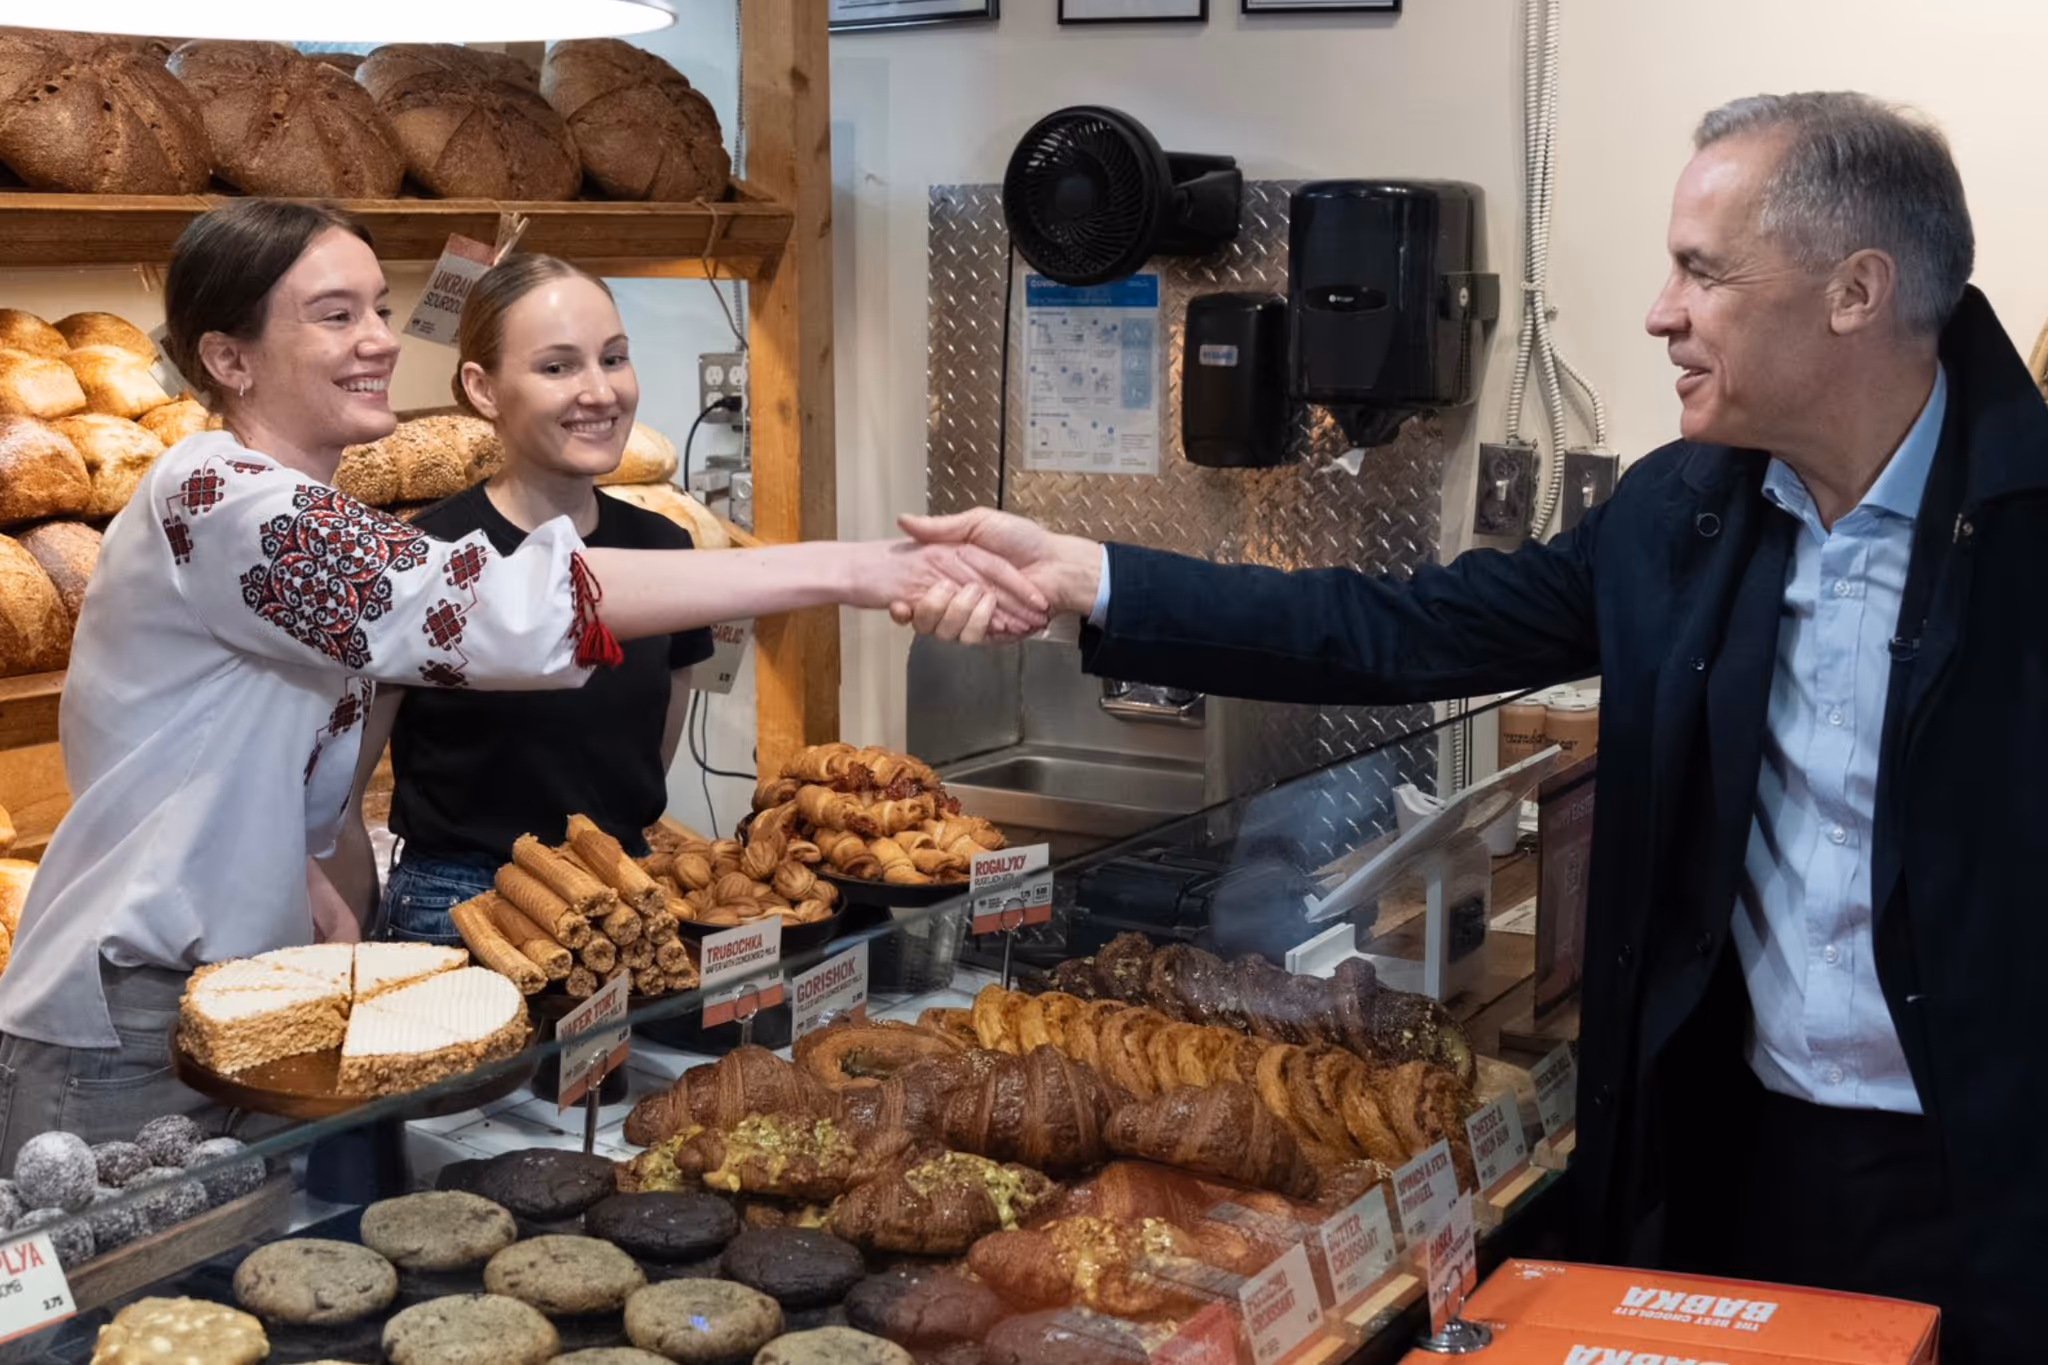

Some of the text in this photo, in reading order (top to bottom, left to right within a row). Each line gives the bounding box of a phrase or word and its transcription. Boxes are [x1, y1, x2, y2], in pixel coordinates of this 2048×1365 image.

[975, 854, 1027, 876] ROGALYKY
[707, 934, 763, 964] TRUBOCHKA
[796, 956, 856, 1003] GORISHOK
[1327, 1214, 1361, 1252] BUTTER
[1332, 1226, 1378, 1275] CROISSANT
[1612, 1307, 1760, 1332] THE BEST CHOCOLATE
[1621, 1286, 1778, 1323] BABKA
